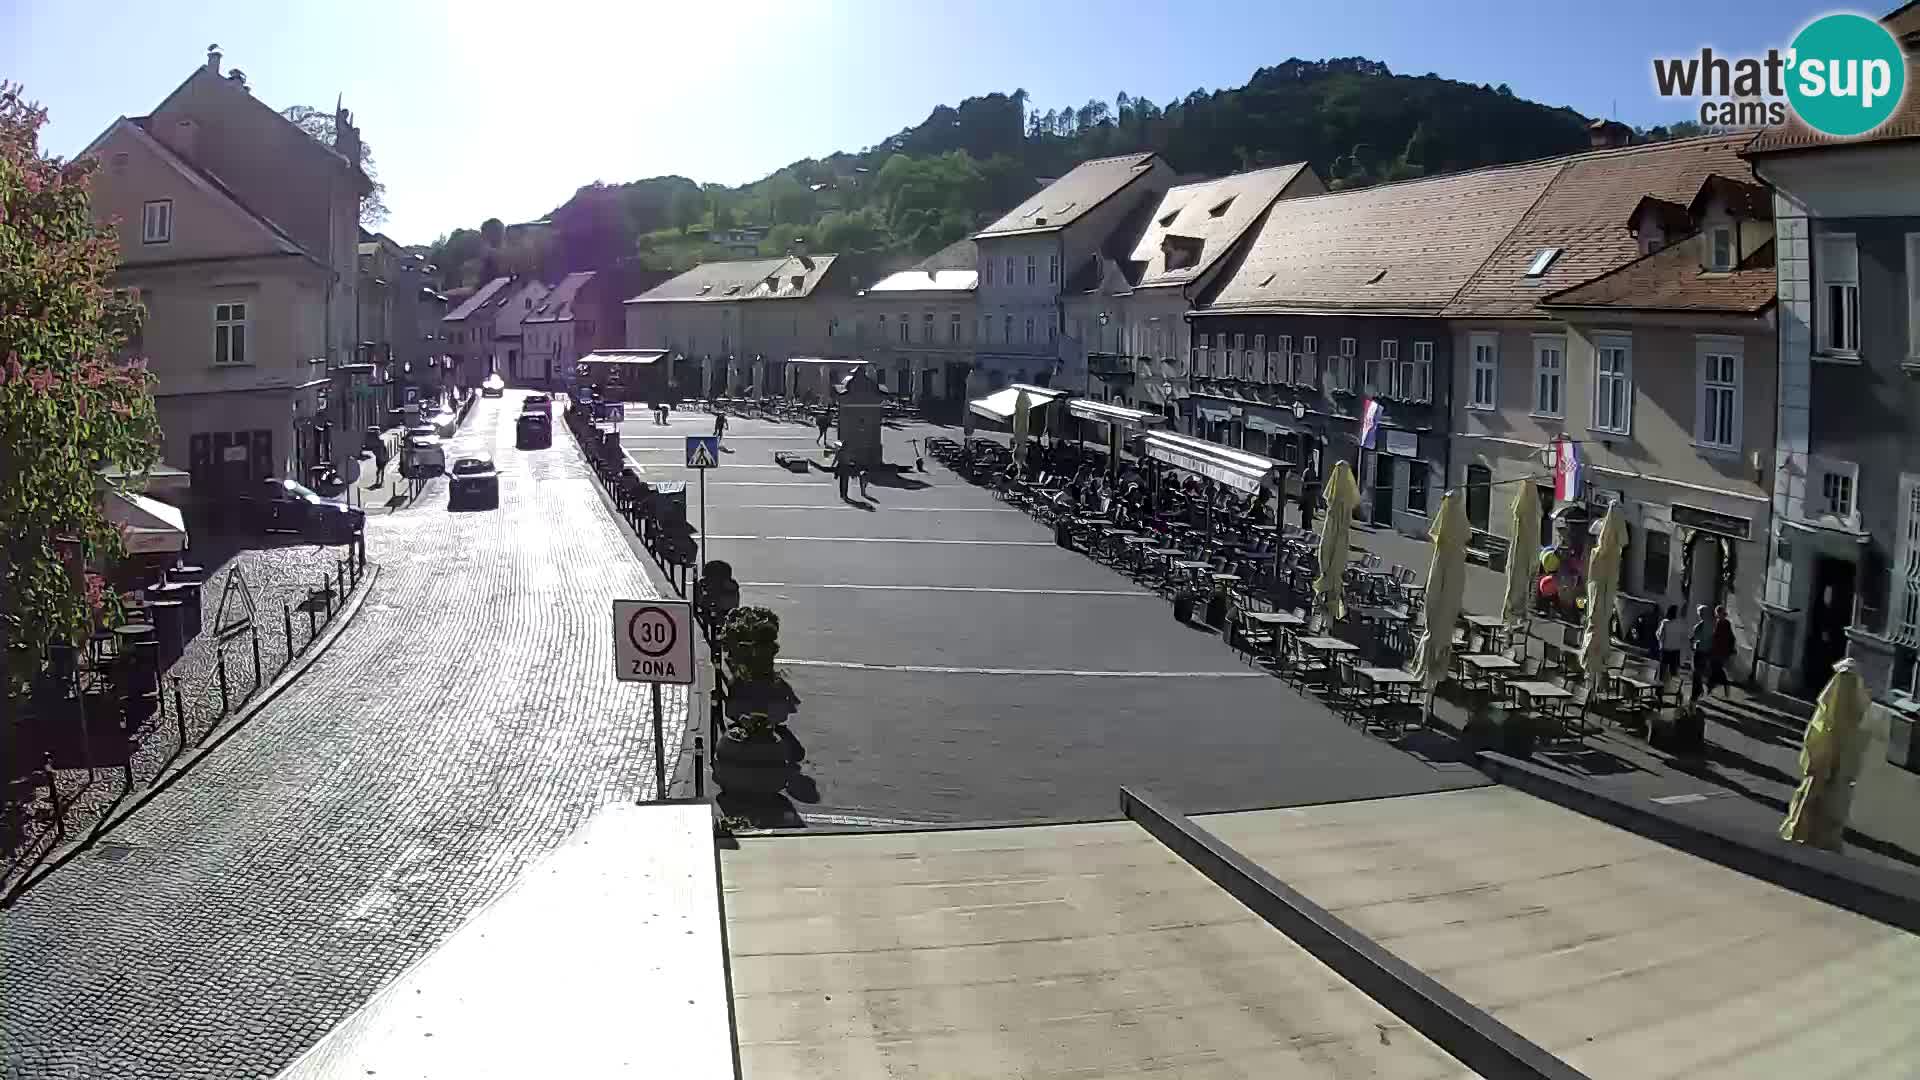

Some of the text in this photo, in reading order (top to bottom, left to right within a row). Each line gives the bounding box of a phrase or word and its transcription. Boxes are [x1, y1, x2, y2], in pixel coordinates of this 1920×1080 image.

[407, 390, 416, 401] P
[641, 622, 665, 643] 30
[631, 660, 676, 677] ZONA
